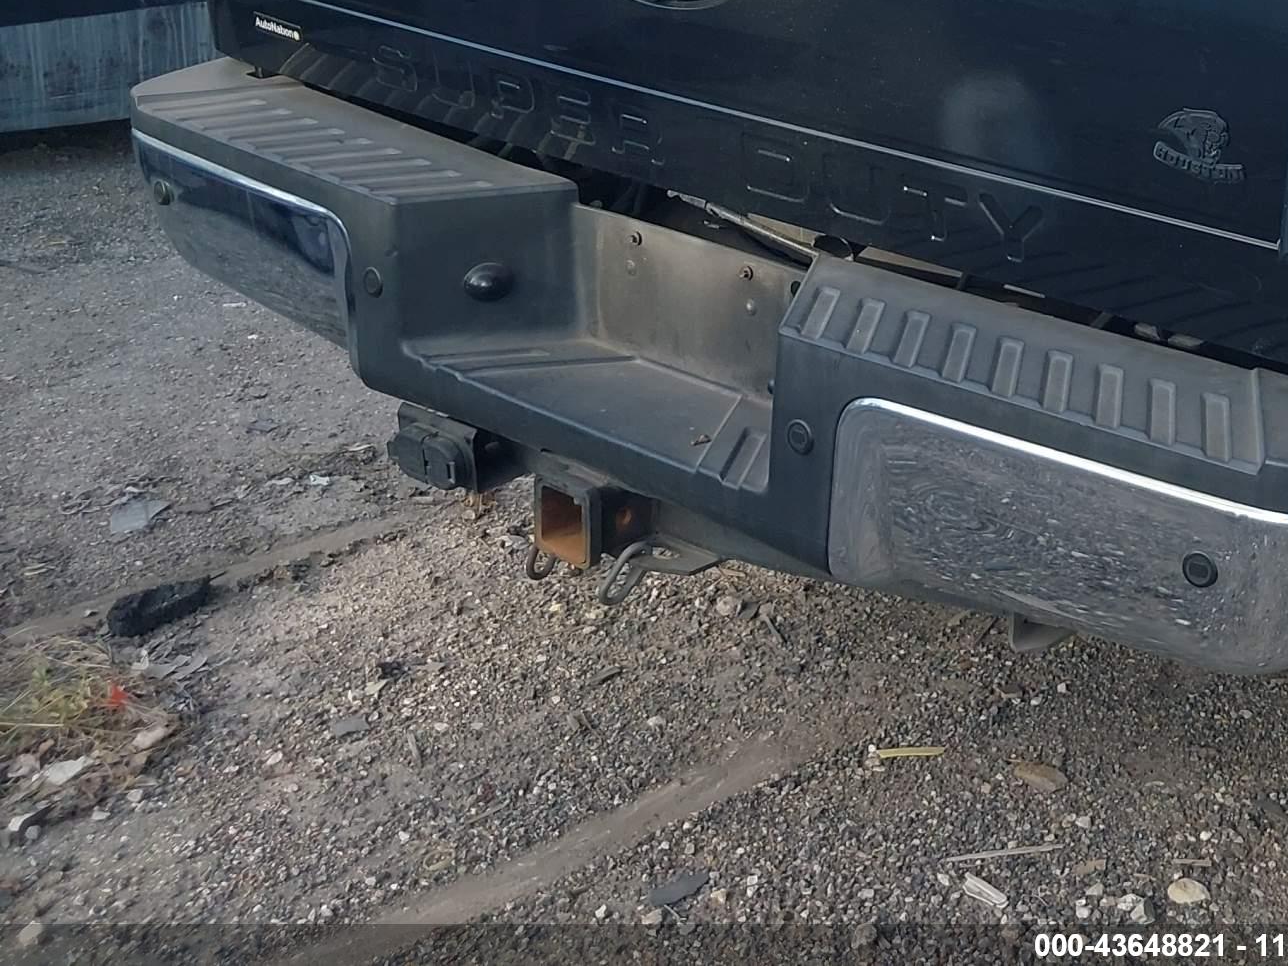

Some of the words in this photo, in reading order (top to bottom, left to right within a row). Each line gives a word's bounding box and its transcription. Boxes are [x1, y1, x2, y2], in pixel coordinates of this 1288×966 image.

[255, 16, 295, 39] AutoNation
[371, 43, 666, 167] SUPER
[742, 132, 1047, 263] DUTY
